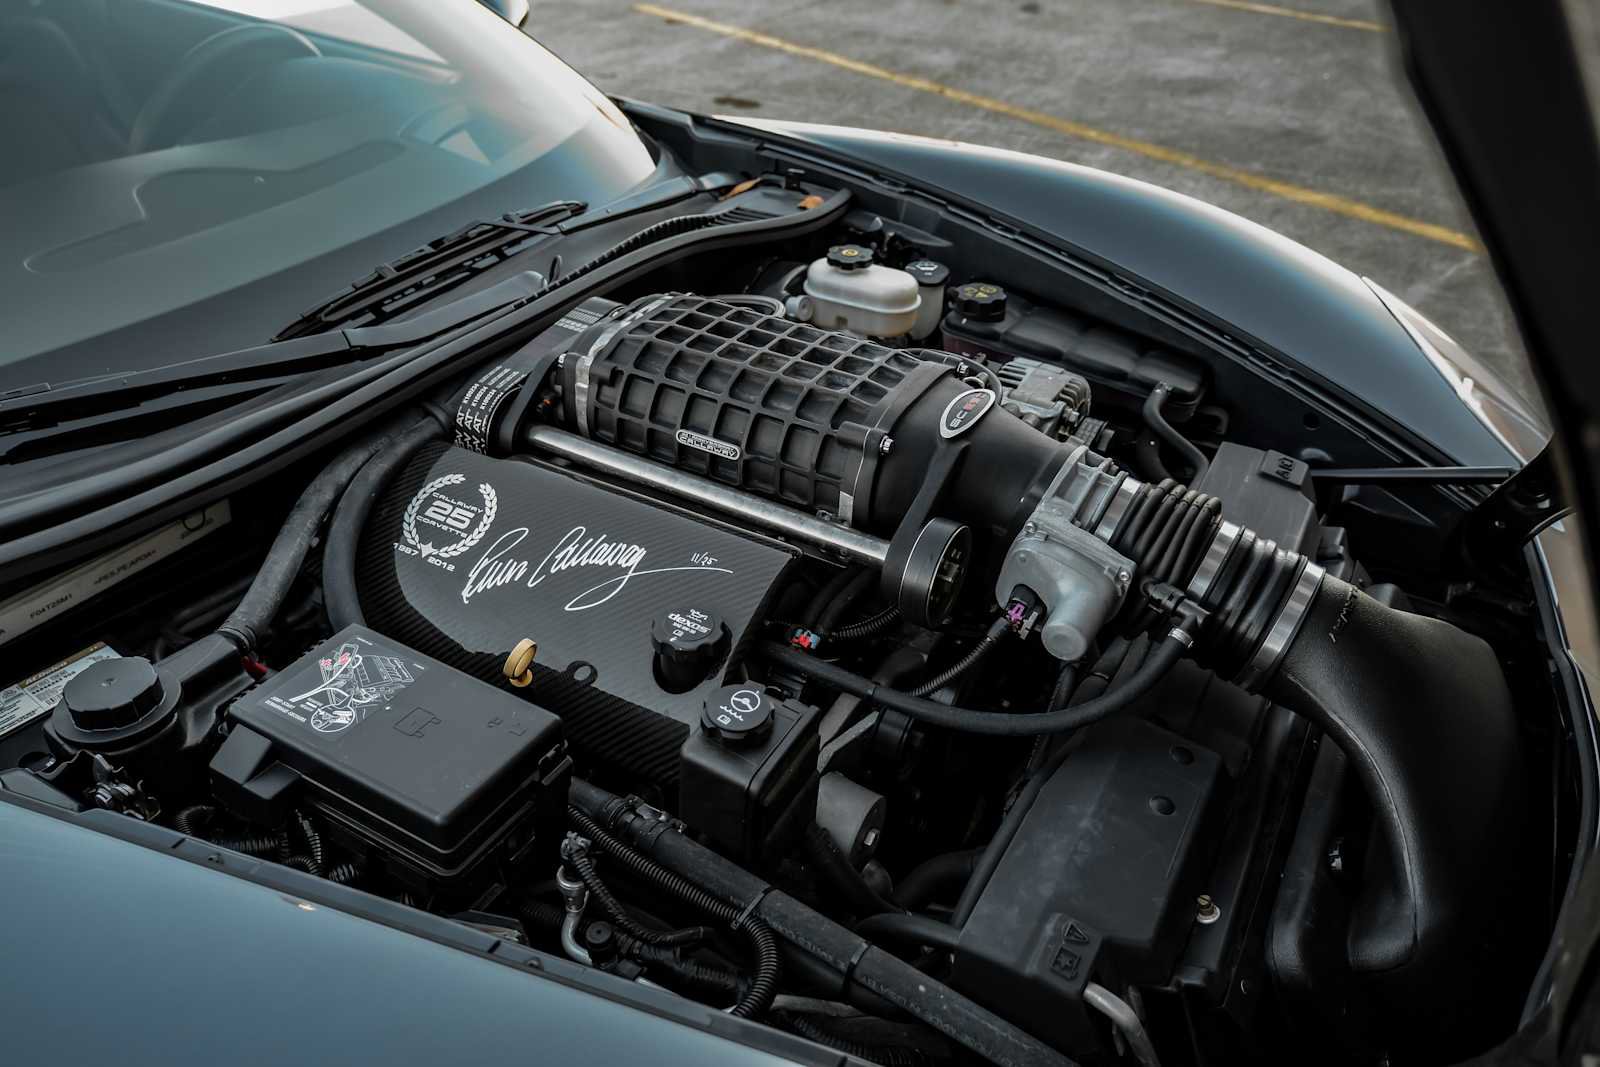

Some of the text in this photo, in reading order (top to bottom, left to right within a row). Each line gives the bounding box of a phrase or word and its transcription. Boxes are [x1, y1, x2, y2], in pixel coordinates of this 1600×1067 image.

[432, 491, 484, 514] CALLAWAY
[424, 500, 475, 530] 25
[415, 515, 468, 538] CORVETTE
[393, 542, 420, 556] 1987
[427, 556, 456, 573] 2012
[667, 613, 712, 634] dexos
